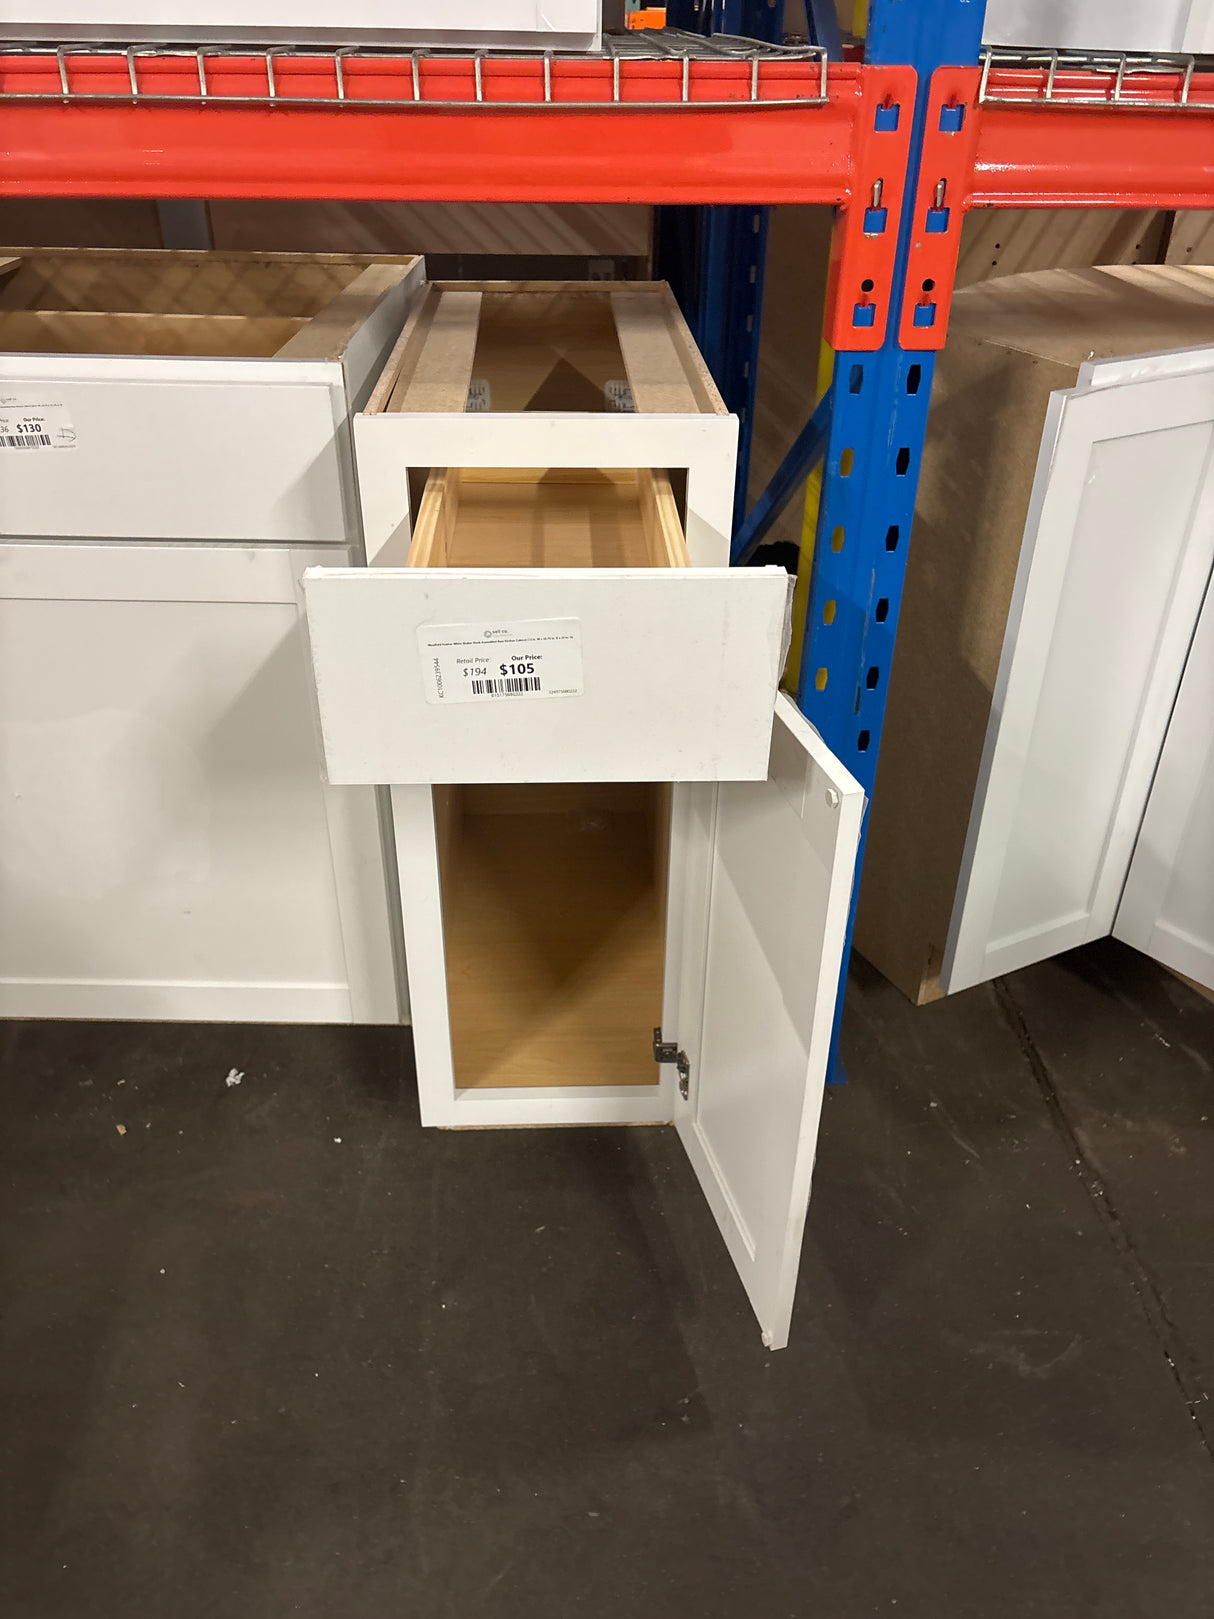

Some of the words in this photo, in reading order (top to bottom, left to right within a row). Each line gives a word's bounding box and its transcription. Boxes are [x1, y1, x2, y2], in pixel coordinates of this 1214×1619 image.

[16, 423, 41, 433] $130
[462, 667, 487, 677] $194
[499, 663, 535, 676] $105
